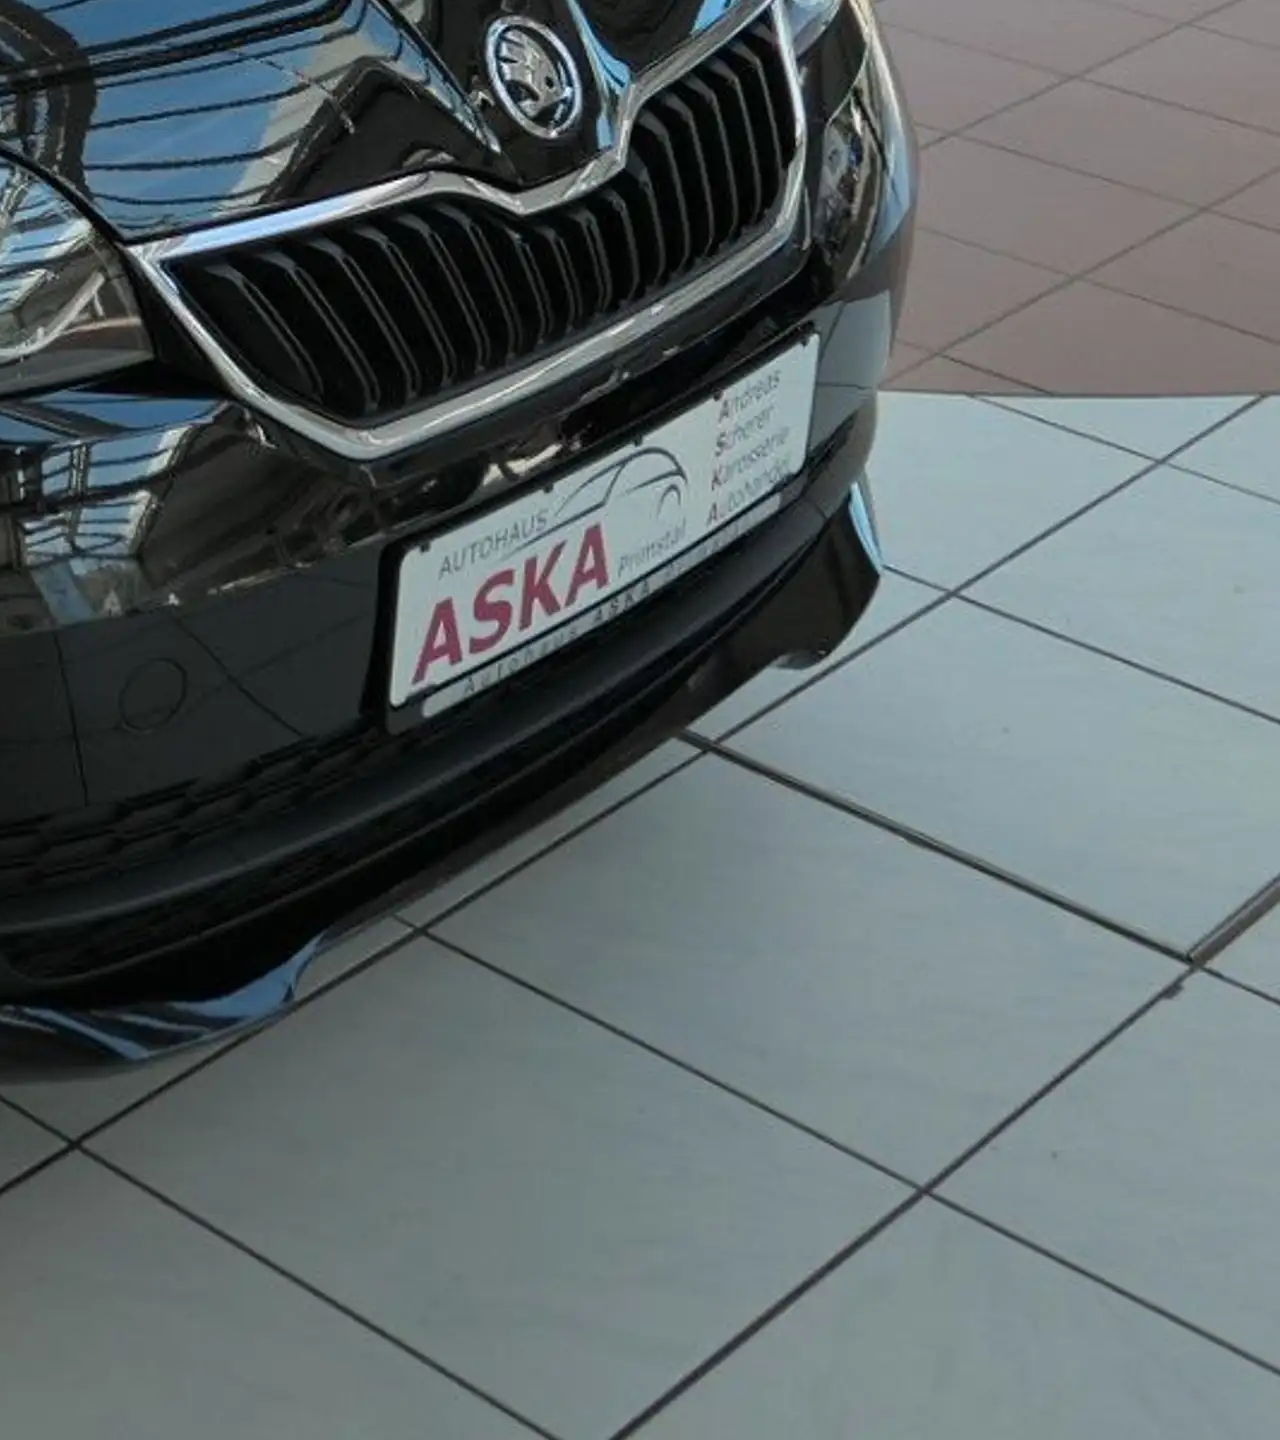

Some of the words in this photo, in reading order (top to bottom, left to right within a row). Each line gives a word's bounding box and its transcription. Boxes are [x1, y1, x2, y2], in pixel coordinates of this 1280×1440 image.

[438, 510, 549, 580] AUTOHAUS
[411, 523, 610, 685] ASKA
[593, 582, 652, 623] ASKA
